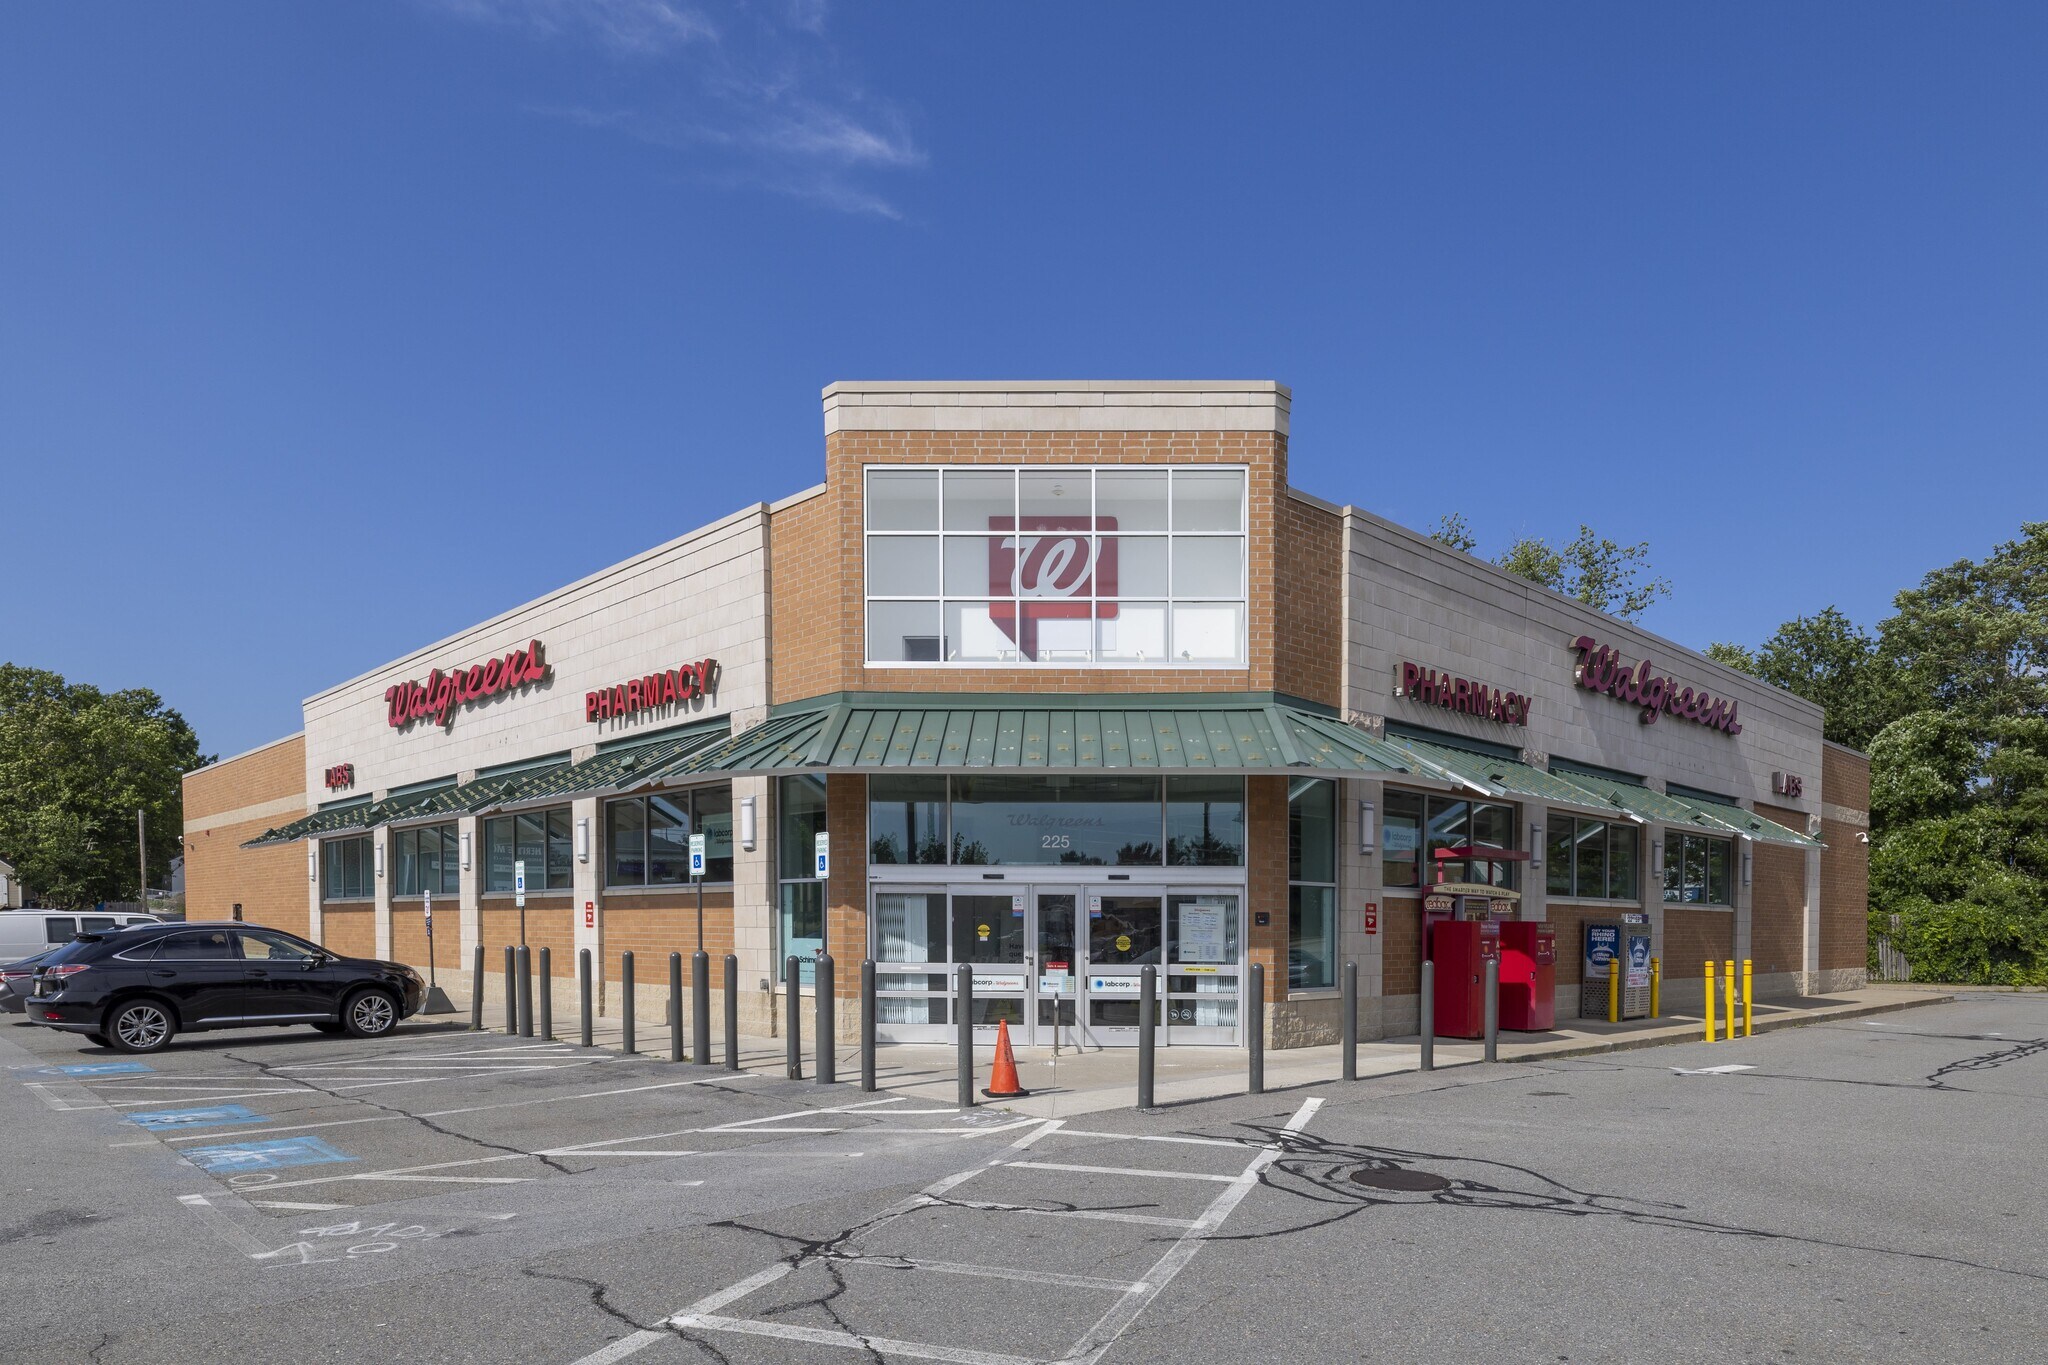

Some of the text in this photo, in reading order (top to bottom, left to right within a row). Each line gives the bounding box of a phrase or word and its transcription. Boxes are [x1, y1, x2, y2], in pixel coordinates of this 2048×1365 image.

[385, 639, 549, 728] Walgreens
[586, 658, 718, 723] PHARMACY
[1397, 661, 1532, 727] PHARMACY
[1570, 635, 1743, 736] Walgreens
[1007, 814, 1106, 830] Walgreens
[1041, 834, 1070, 848] 225
[1105, 980, 1131, 988] labcorp
